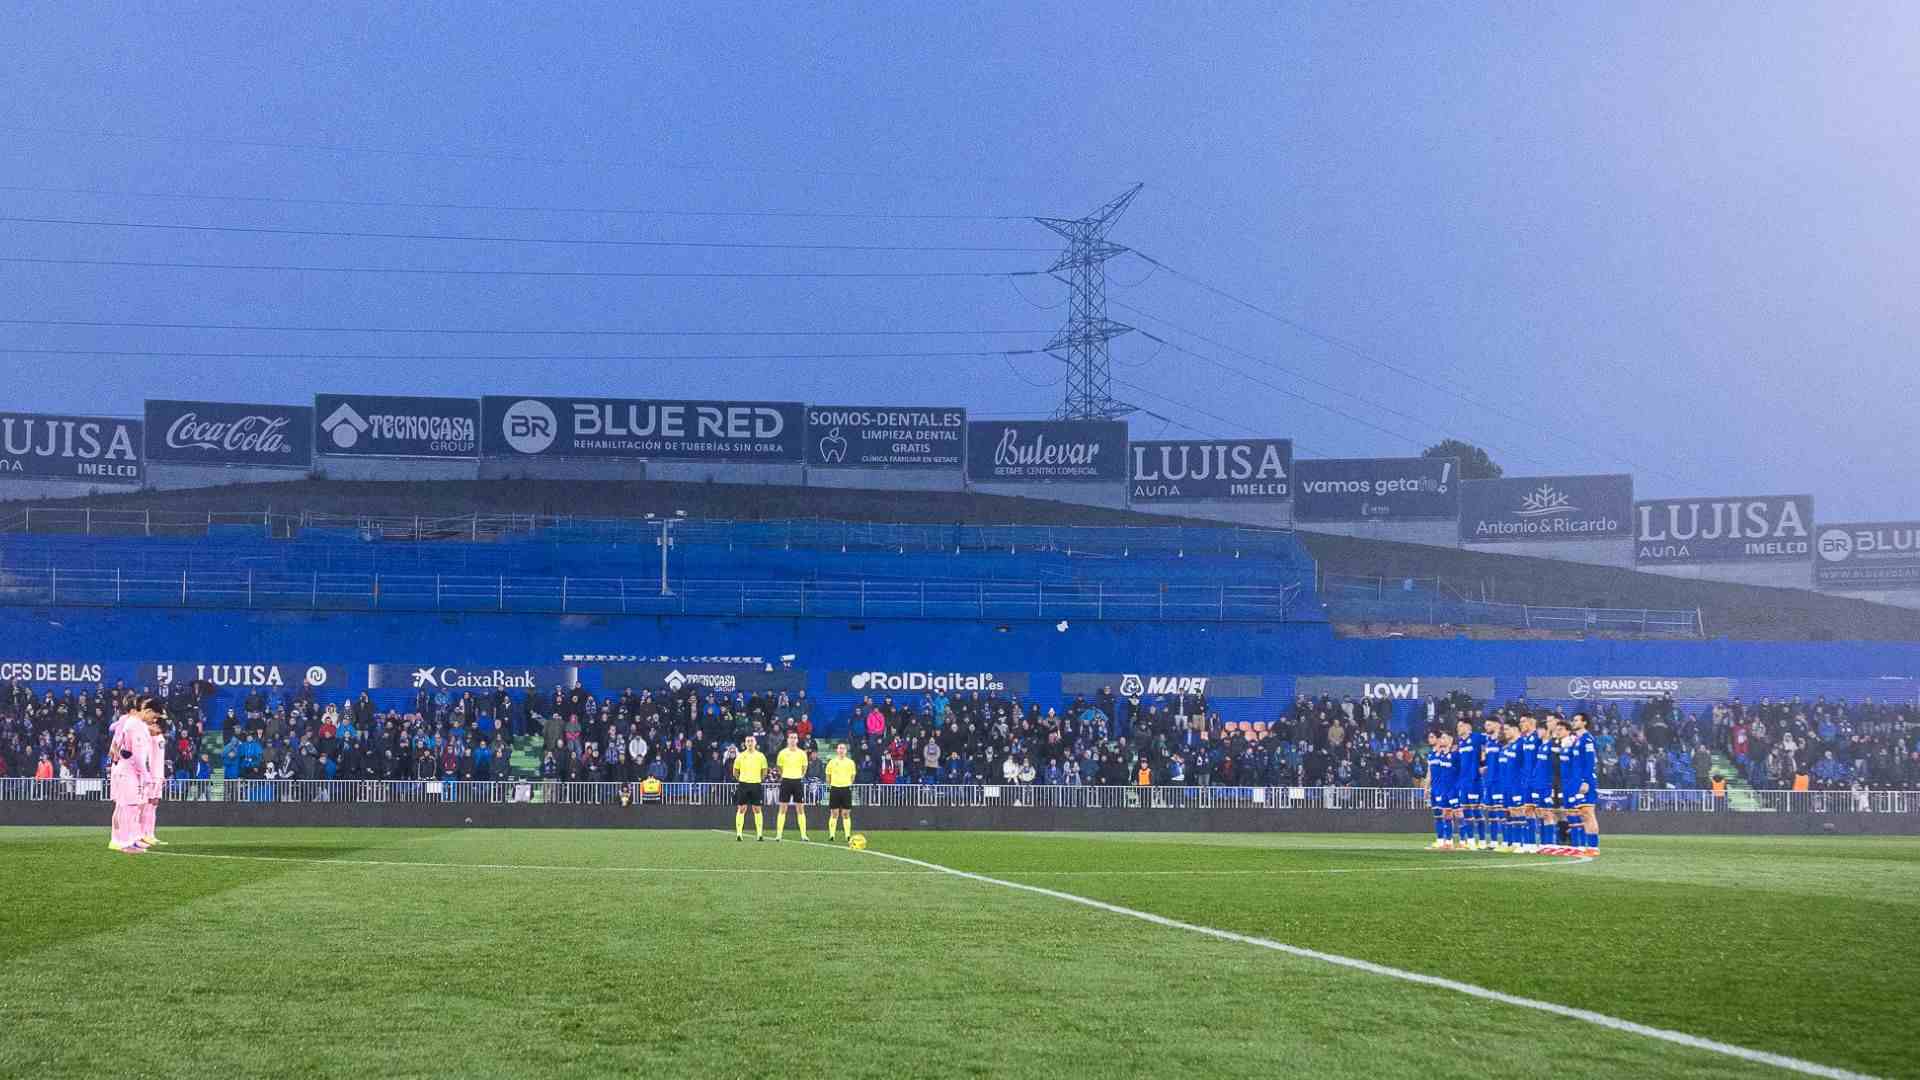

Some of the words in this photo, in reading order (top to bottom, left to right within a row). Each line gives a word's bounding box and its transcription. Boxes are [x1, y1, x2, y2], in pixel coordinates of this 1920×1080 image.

[369, 414, 474, 441] TECNOCASA
[511, 415, 551, 437] BR
[572, 403, 685, 437] BLUE
[695, 406, 784, 438] RED
[809, 411, 961, 427] SOMOS-DENTAL.ES
[861, 430, 913, 441] LIMPIEZA
[916, 430, 959, 441] DENTAL
[430, 441, 474, 452] GROUP
[664, 440, 678, 450] DE
[734, 442, 751, 451] SIN
[754, 443, 784, 453] OBRA
[891, 443, 931, 454] GRATIS
[995, 427, 1099, 465] Bulevar
[78, 463, 137, 477] IMELCO
[1133, 444, 1288, 481] LUJISA
[1231, 483, 1288, 496] IMELCO
[1303, 480, 1371, 494] vamos
[1639, 500, 1808, 542] LUJISA
[1745, 541, 1808, 555] IMELCO
[1855, 529, 1920, 551] BLU
[36, 664, 57, 681] DE
[60, 664, 102, 682] BLAS
[197, 665, 284, 686] LUJISA
[440, 667, 535, 688] CaixaBank
[1147, 677, 1208, 694] MAPEI
[1592, 680, 1637, 690] GRAND
[1639, 681, 1679, 690] CLASS
